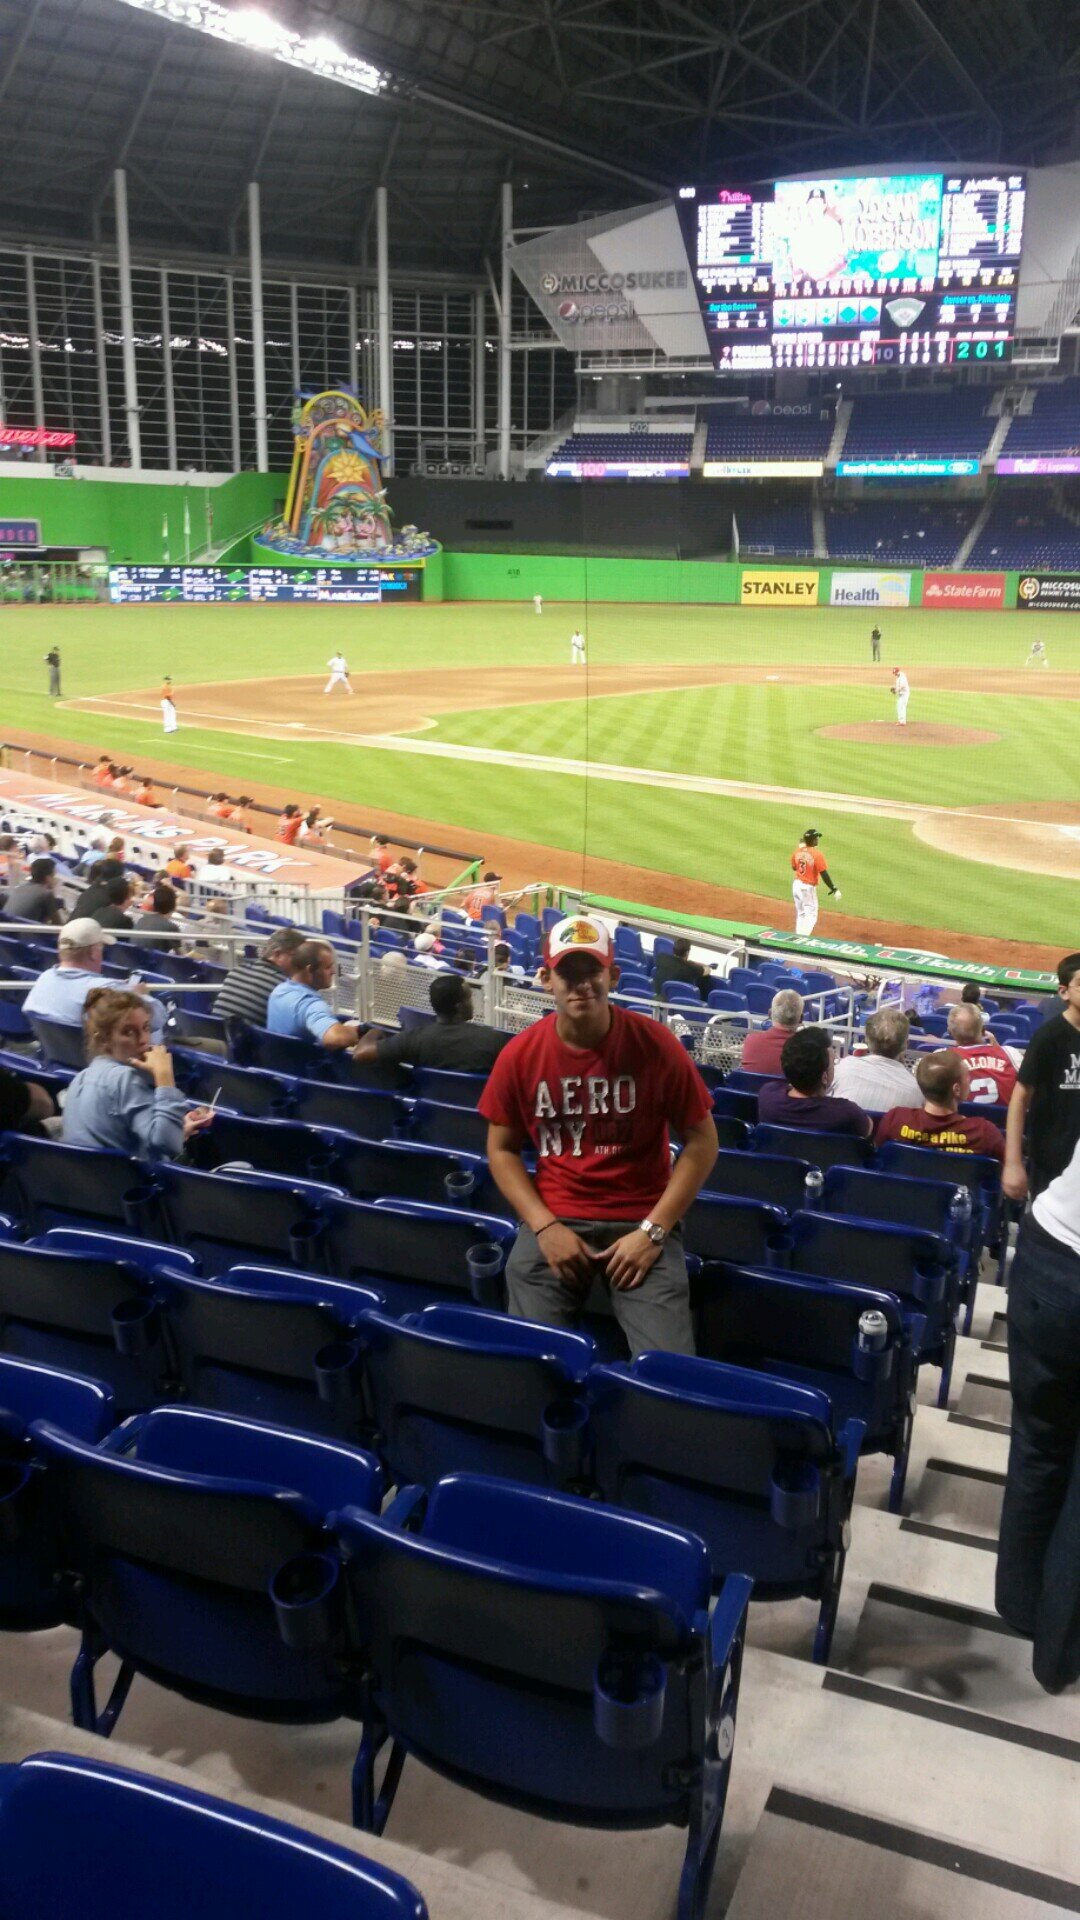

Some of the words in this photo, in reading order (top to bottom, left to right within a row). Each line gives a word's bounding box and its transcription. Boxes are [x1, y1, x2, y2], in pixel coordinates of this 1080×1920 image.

[559, 270, 688, 293] MICCOSUKEE
[580, 301, 635, 322] pepsi
[958, 342, 970, 359] 2
[975, 341, 988, 358] 0
[994, 341, 1005, 358] 1
[743, 581, 816, 595] STANLEY
[834, 588, 880, 601] Health
[173, 836, 314, 874] PARK
[963, 1055, 1006, 1072] ALONE
[535, 1074, 637, 1119] AERO
[970, 1077, 999, 1104] 2
[538, 1119, 586, 1158] NY
[900, 1124, 930, 1143] Once
[931, 1133, 939, 1143] a
[939, 1130, 967, 1145] Pike
